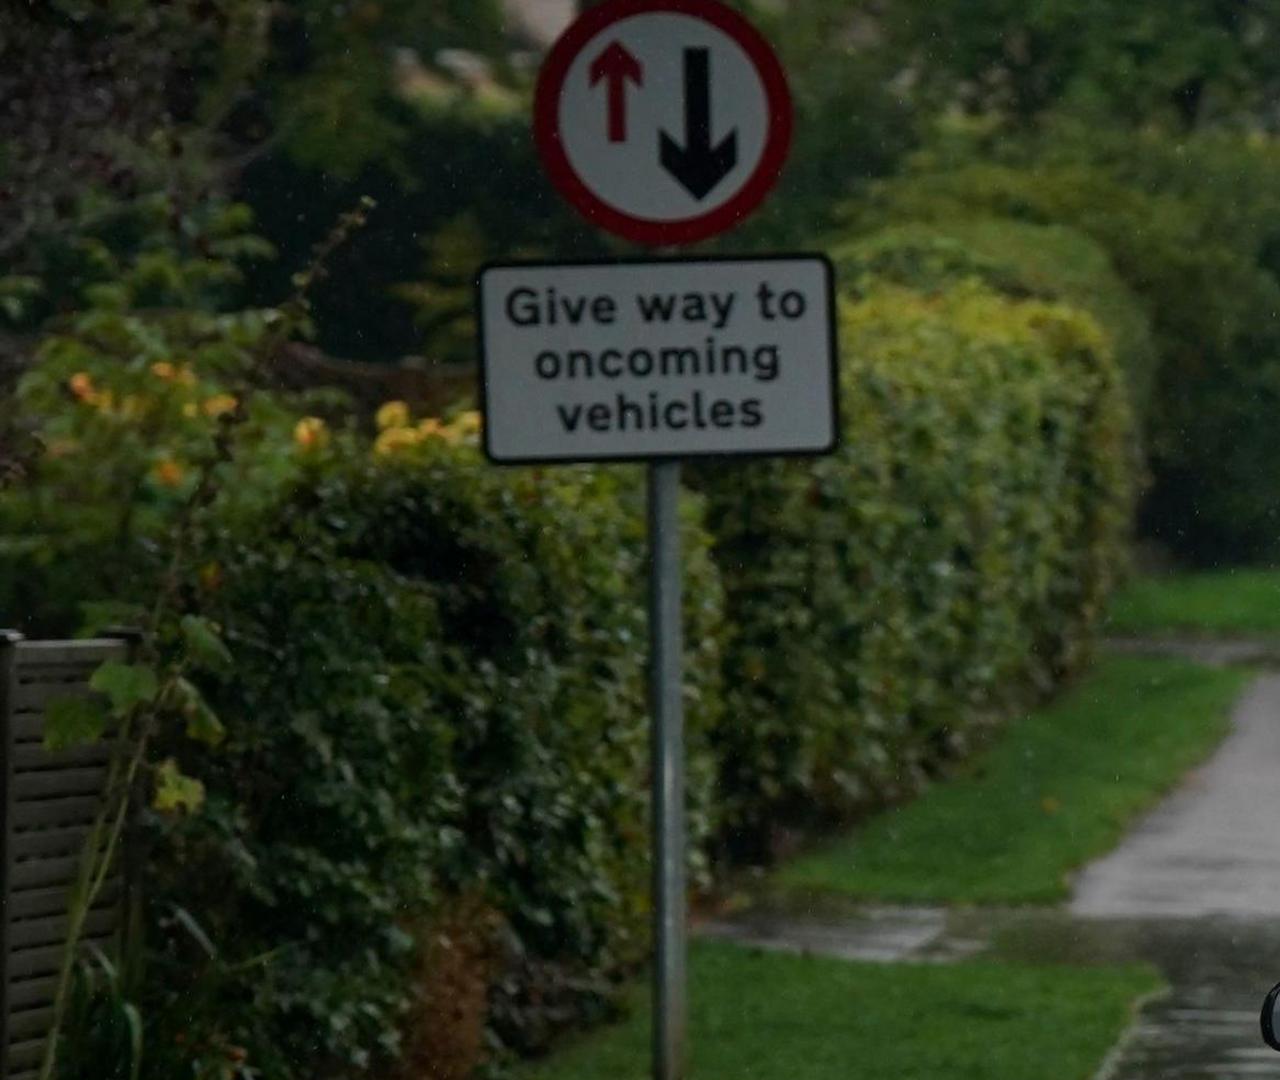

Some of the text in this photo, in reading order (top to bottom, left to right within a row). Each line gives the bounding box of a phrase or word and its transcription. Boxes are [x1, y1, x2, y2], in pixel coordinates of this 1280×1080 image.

[504, 282, 807, 329] Give way to
[534, 337, 781, 382] oncoming
[556, 392, 765, 433] vehicles
